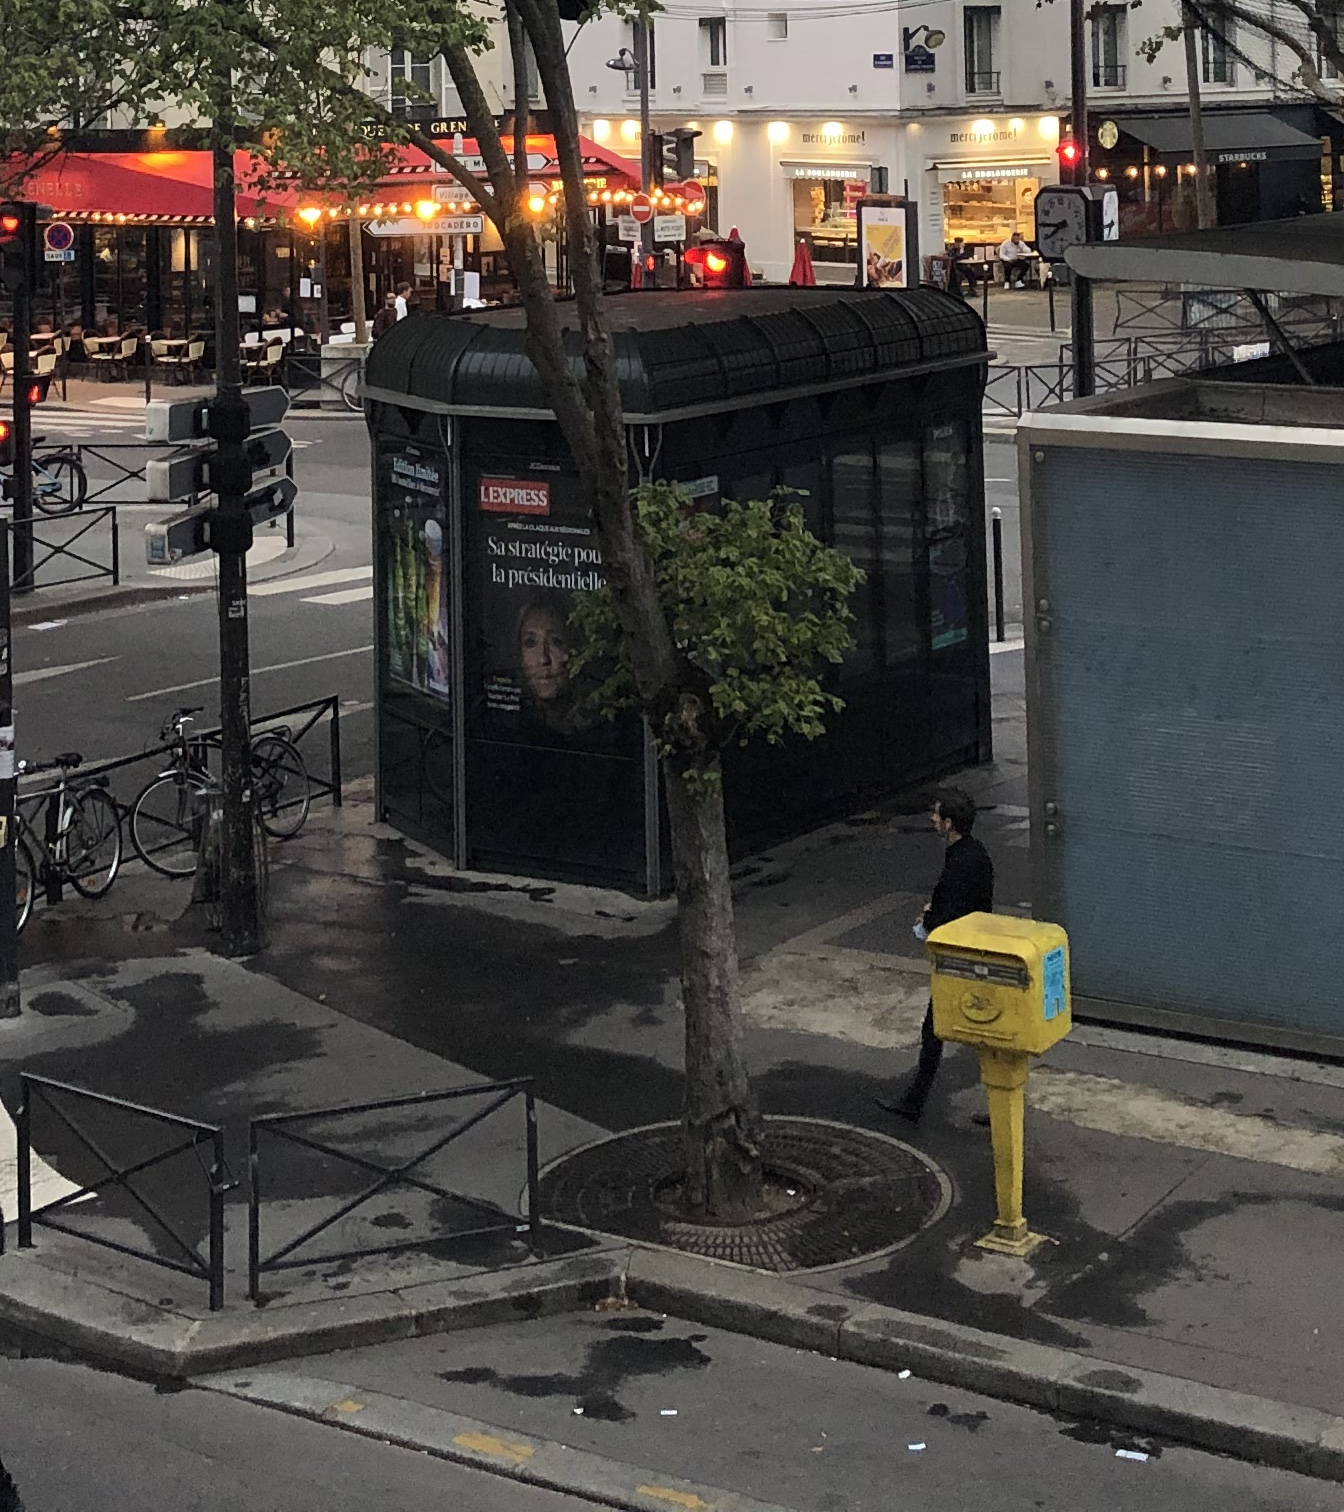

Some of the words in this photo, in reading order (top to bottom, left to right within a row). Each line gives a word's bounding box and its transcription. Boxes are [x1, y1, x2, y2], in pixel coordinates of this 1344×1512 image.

[1218, 152, 1267, 162] STARBUCKS
[807, 169, 857, 178] BOULANGERIE
[961, 170, 972, 178] LA
[975, 169, 1028, 177] BOULANGERIE
[487, 535, 505, 556] Sa
[508, 541, 572, 565] stratégie
[574, 547, 602, 567] pou
[492, 563, 506, 583] la
[508, 566, 607, 591] présidentielle
